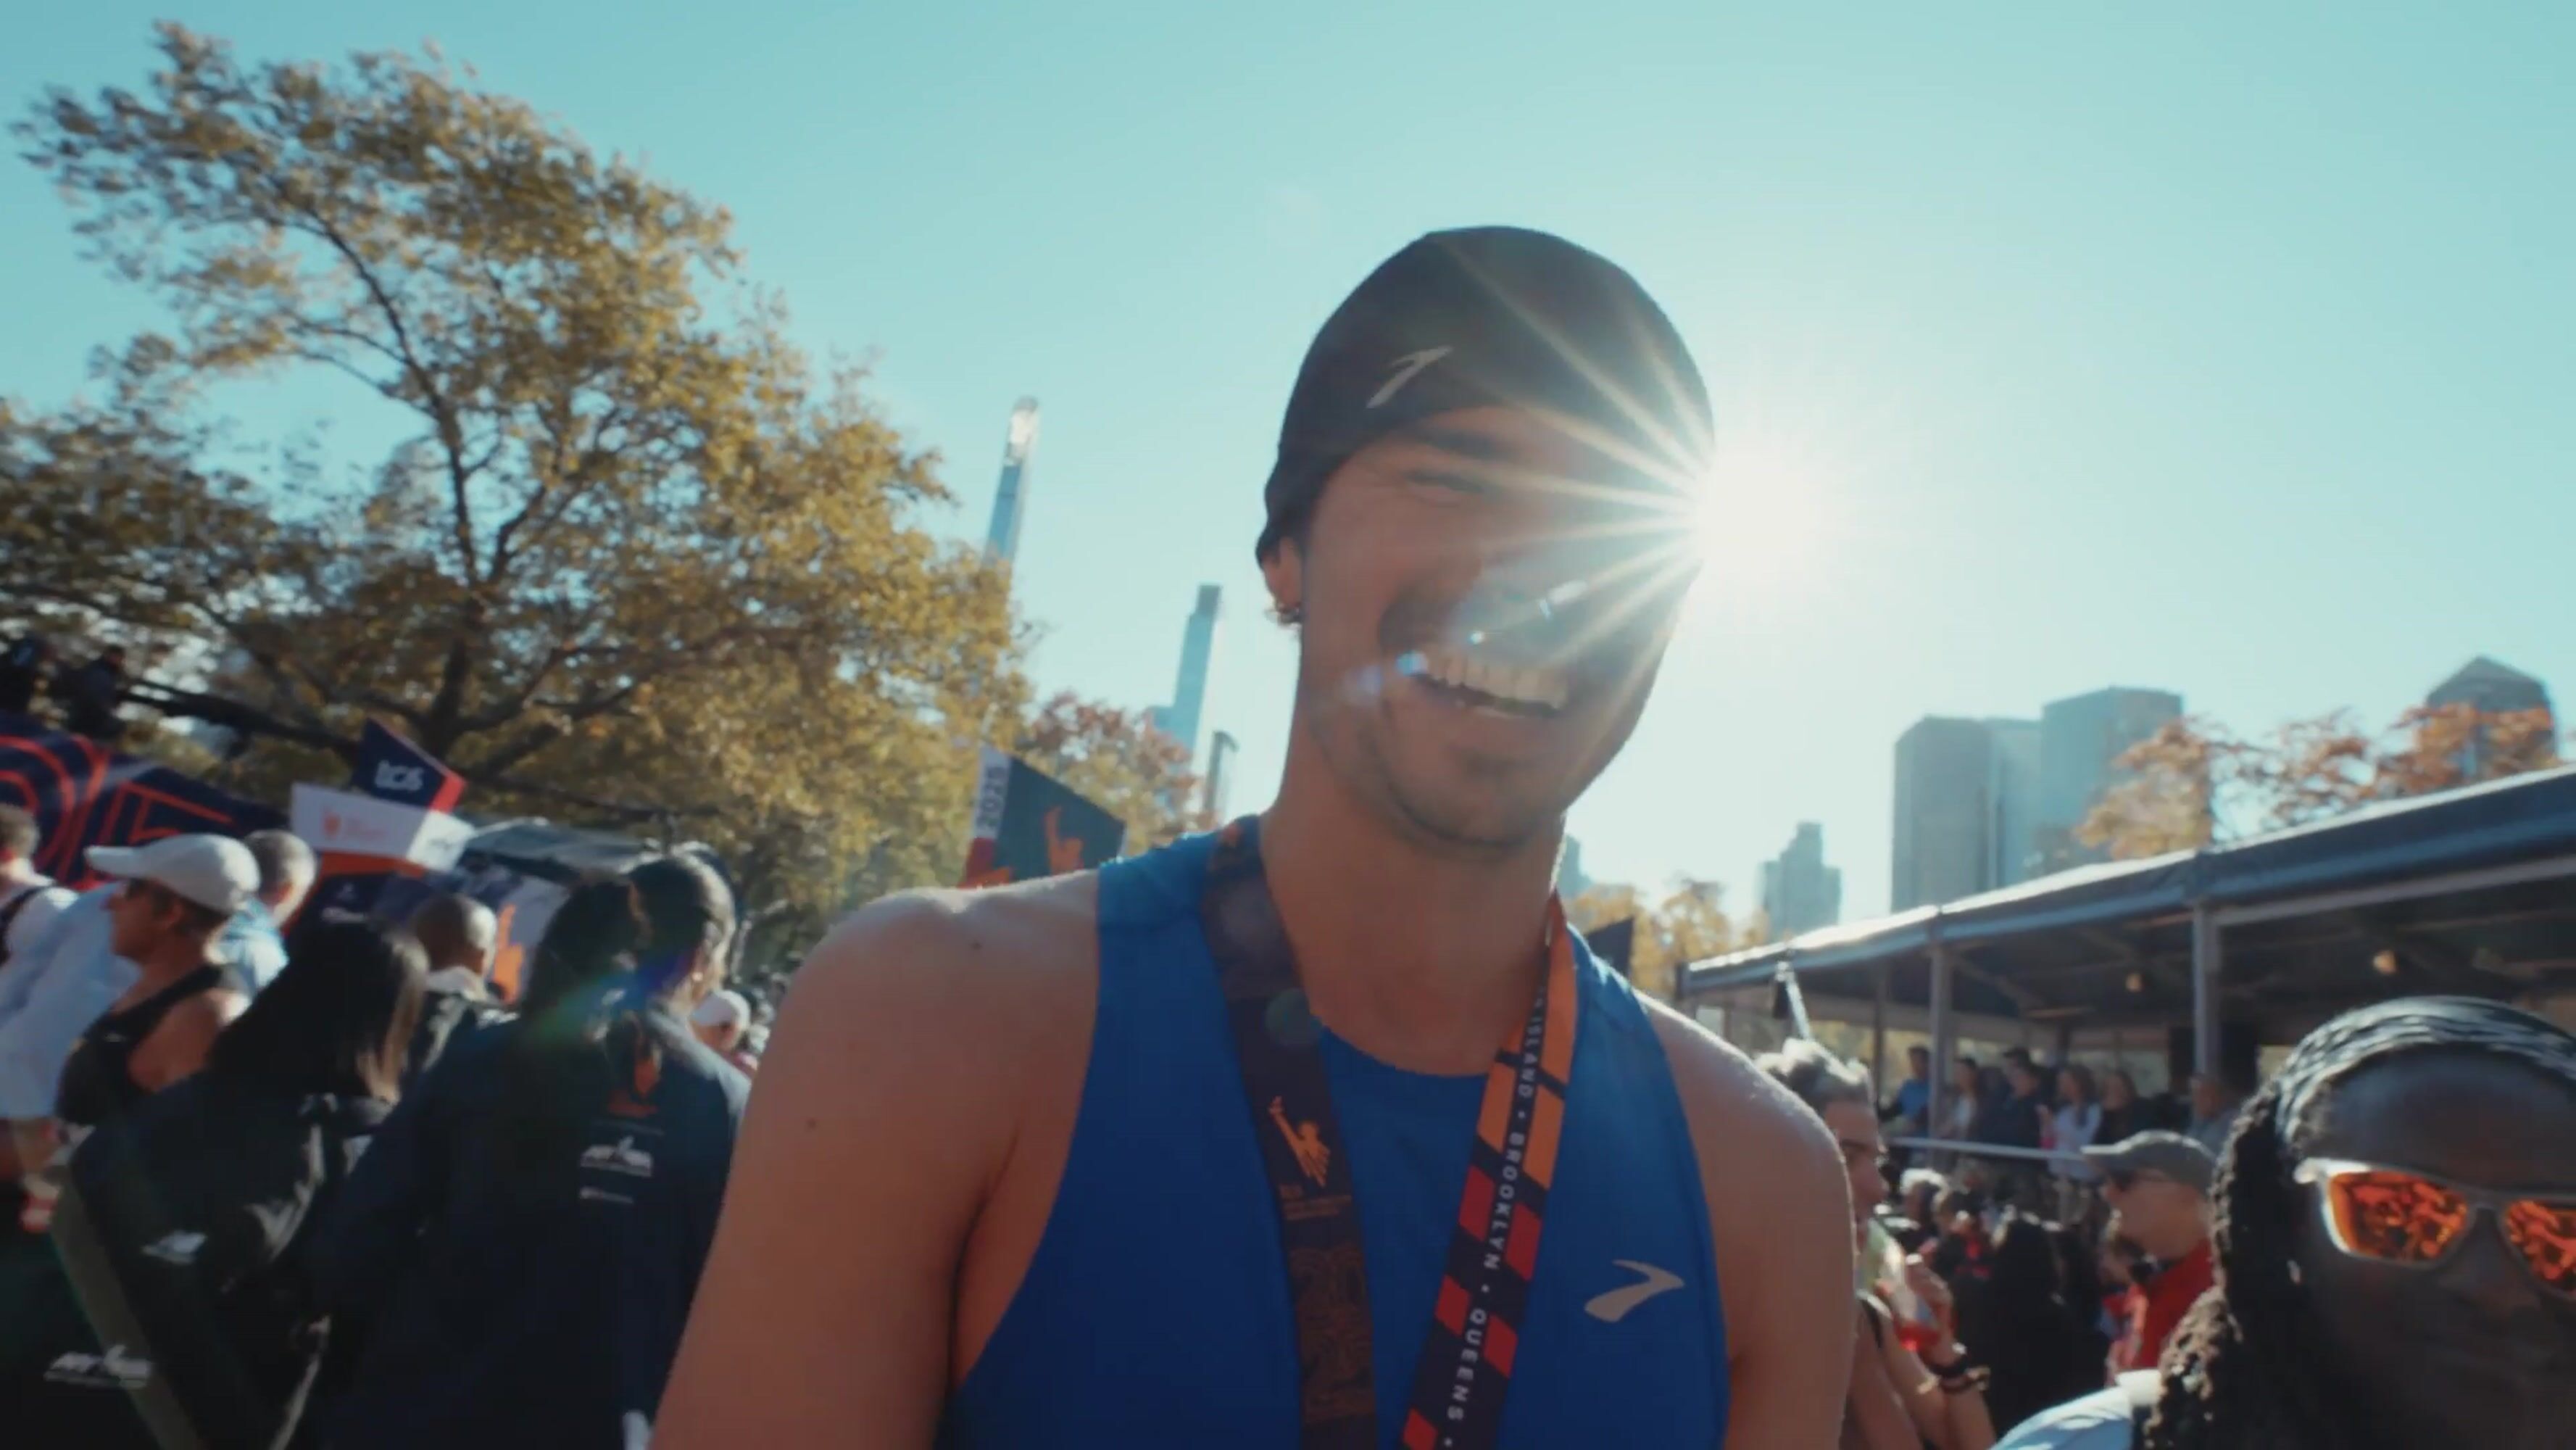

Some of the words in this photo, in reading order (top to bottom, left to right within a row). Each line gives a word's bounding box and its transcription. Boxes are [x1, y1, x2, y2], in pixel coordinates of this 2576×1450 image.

[1518, 1016, 1543, 1098] ISLAND
[1483, 1132, 1525, 1270] BROOKLYN
[1447, 1308, 1487, 1420] QUEENS
